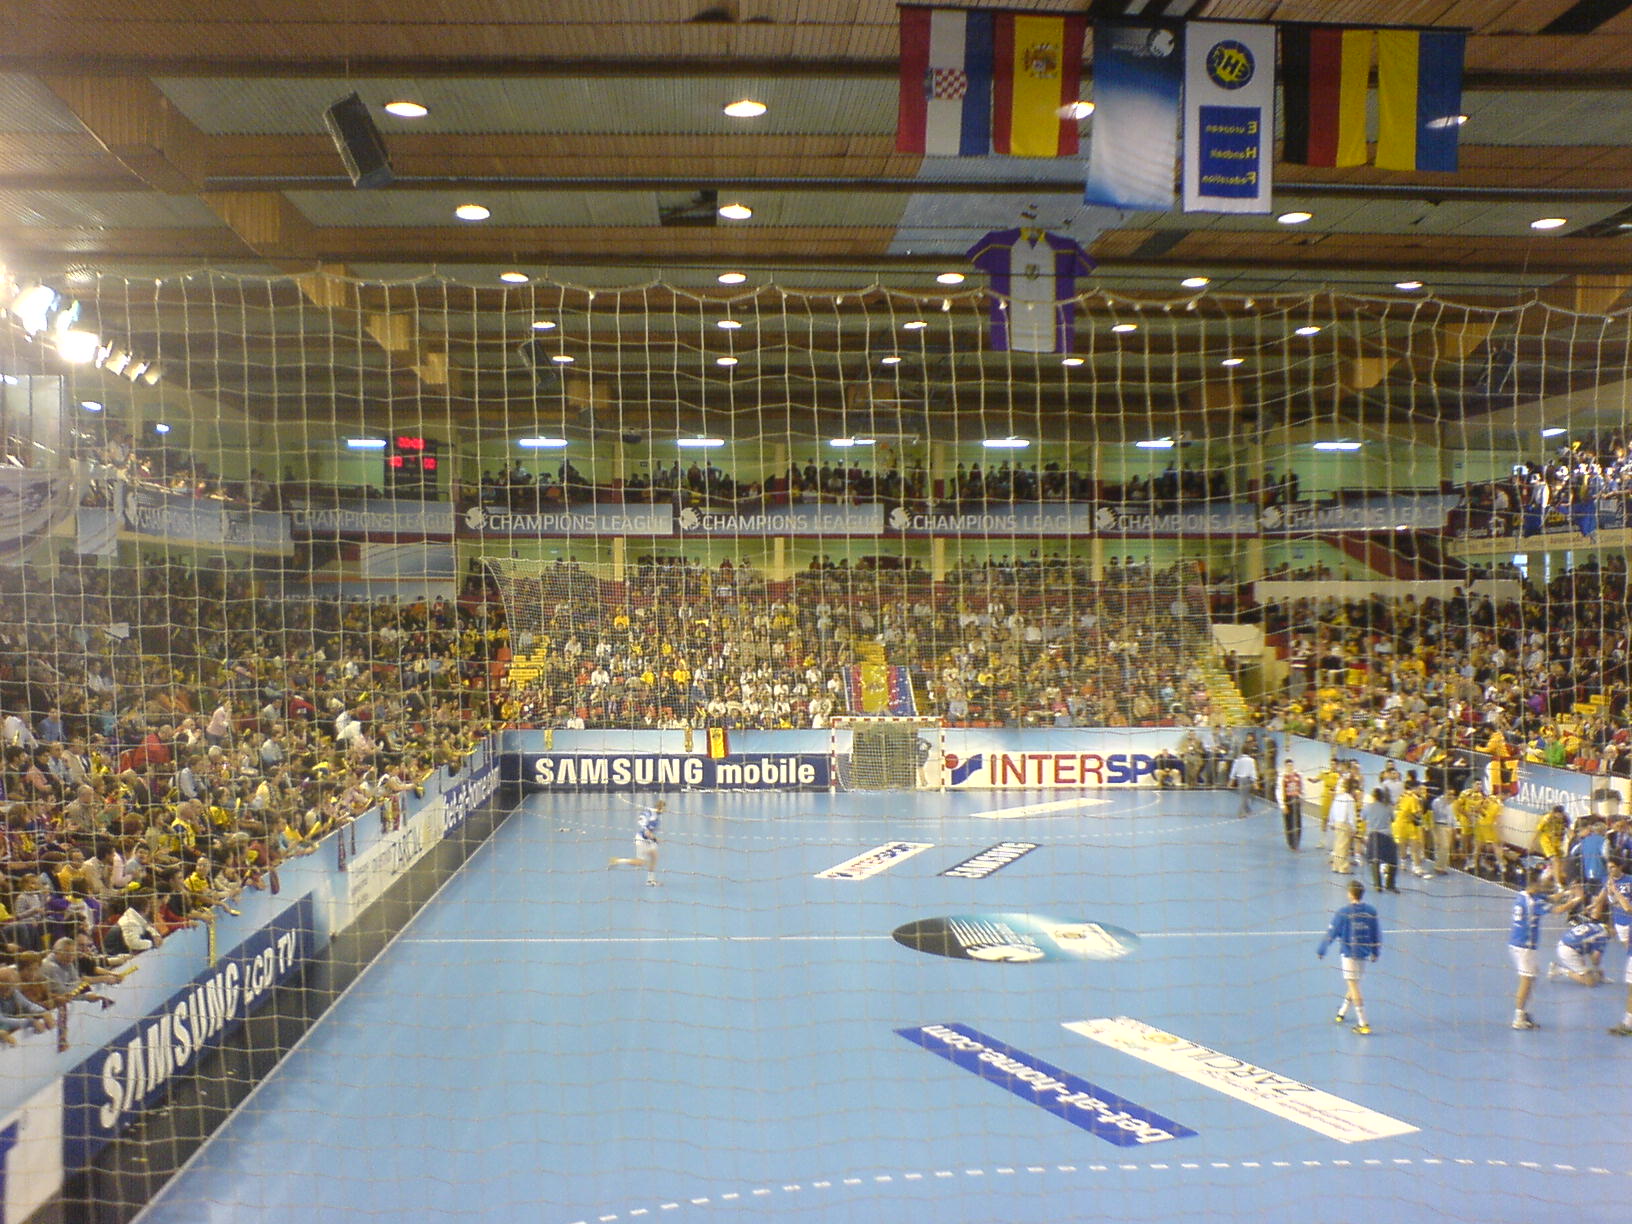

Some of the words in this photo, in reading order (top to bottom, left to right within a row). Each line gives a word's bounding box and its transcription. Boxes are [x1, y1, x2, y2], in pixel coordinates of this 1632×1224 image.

[490, 514, 593, 530] CHAMPIONS
[602, 515, 669, 530] LEAGUE
[703, 515, 807, 530] CHAMPIONS
[913, 515, 1017, 530] CHAMPIONS
[535, 758, 703, 785] SAMSUNG
[716, 758, 815, 784] mobile
[990, 753, 1179, 785] INTERSP
[100, 962, 240, 1129] SAMSUNG
[244, 947, 274, 1006] LCD
[277, 928, 297, 974] TV
